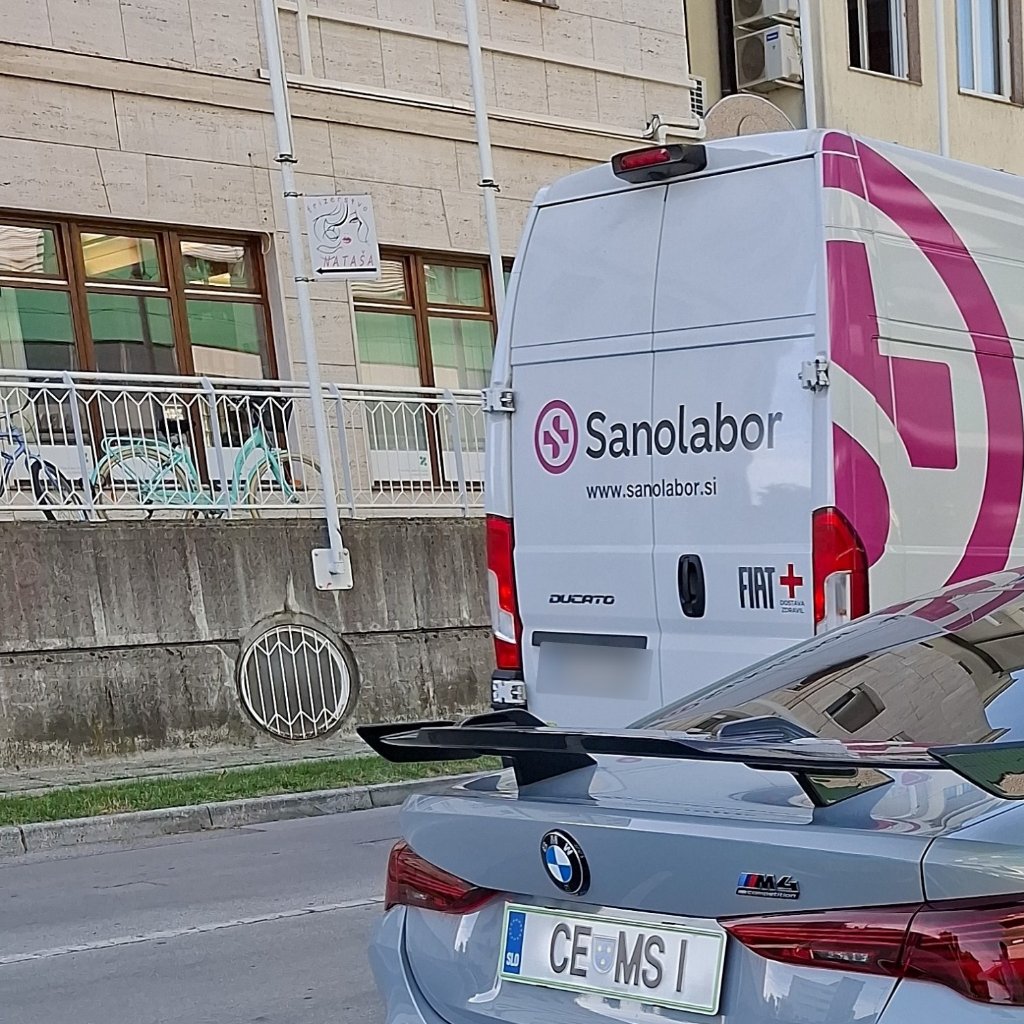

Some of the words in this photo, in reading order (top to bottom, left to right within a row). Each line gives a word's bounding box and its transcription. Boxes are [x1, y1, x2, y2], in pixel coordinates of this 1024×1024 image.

[323, 251, 374, 267] NATAŠA
[586, 402, 783, 458] Sanolabor
[587, 477, 717, 498] www.sanolabor.si
[739, 567, 775, 609] FIAT
[549, 594, 615, 605] DUCATO
[542, 835, 573, 855] BMW
[756, 873, 799, 892] M4
[506, 952, 520, 967] SLO
[550, 922, 592, 977] CE
